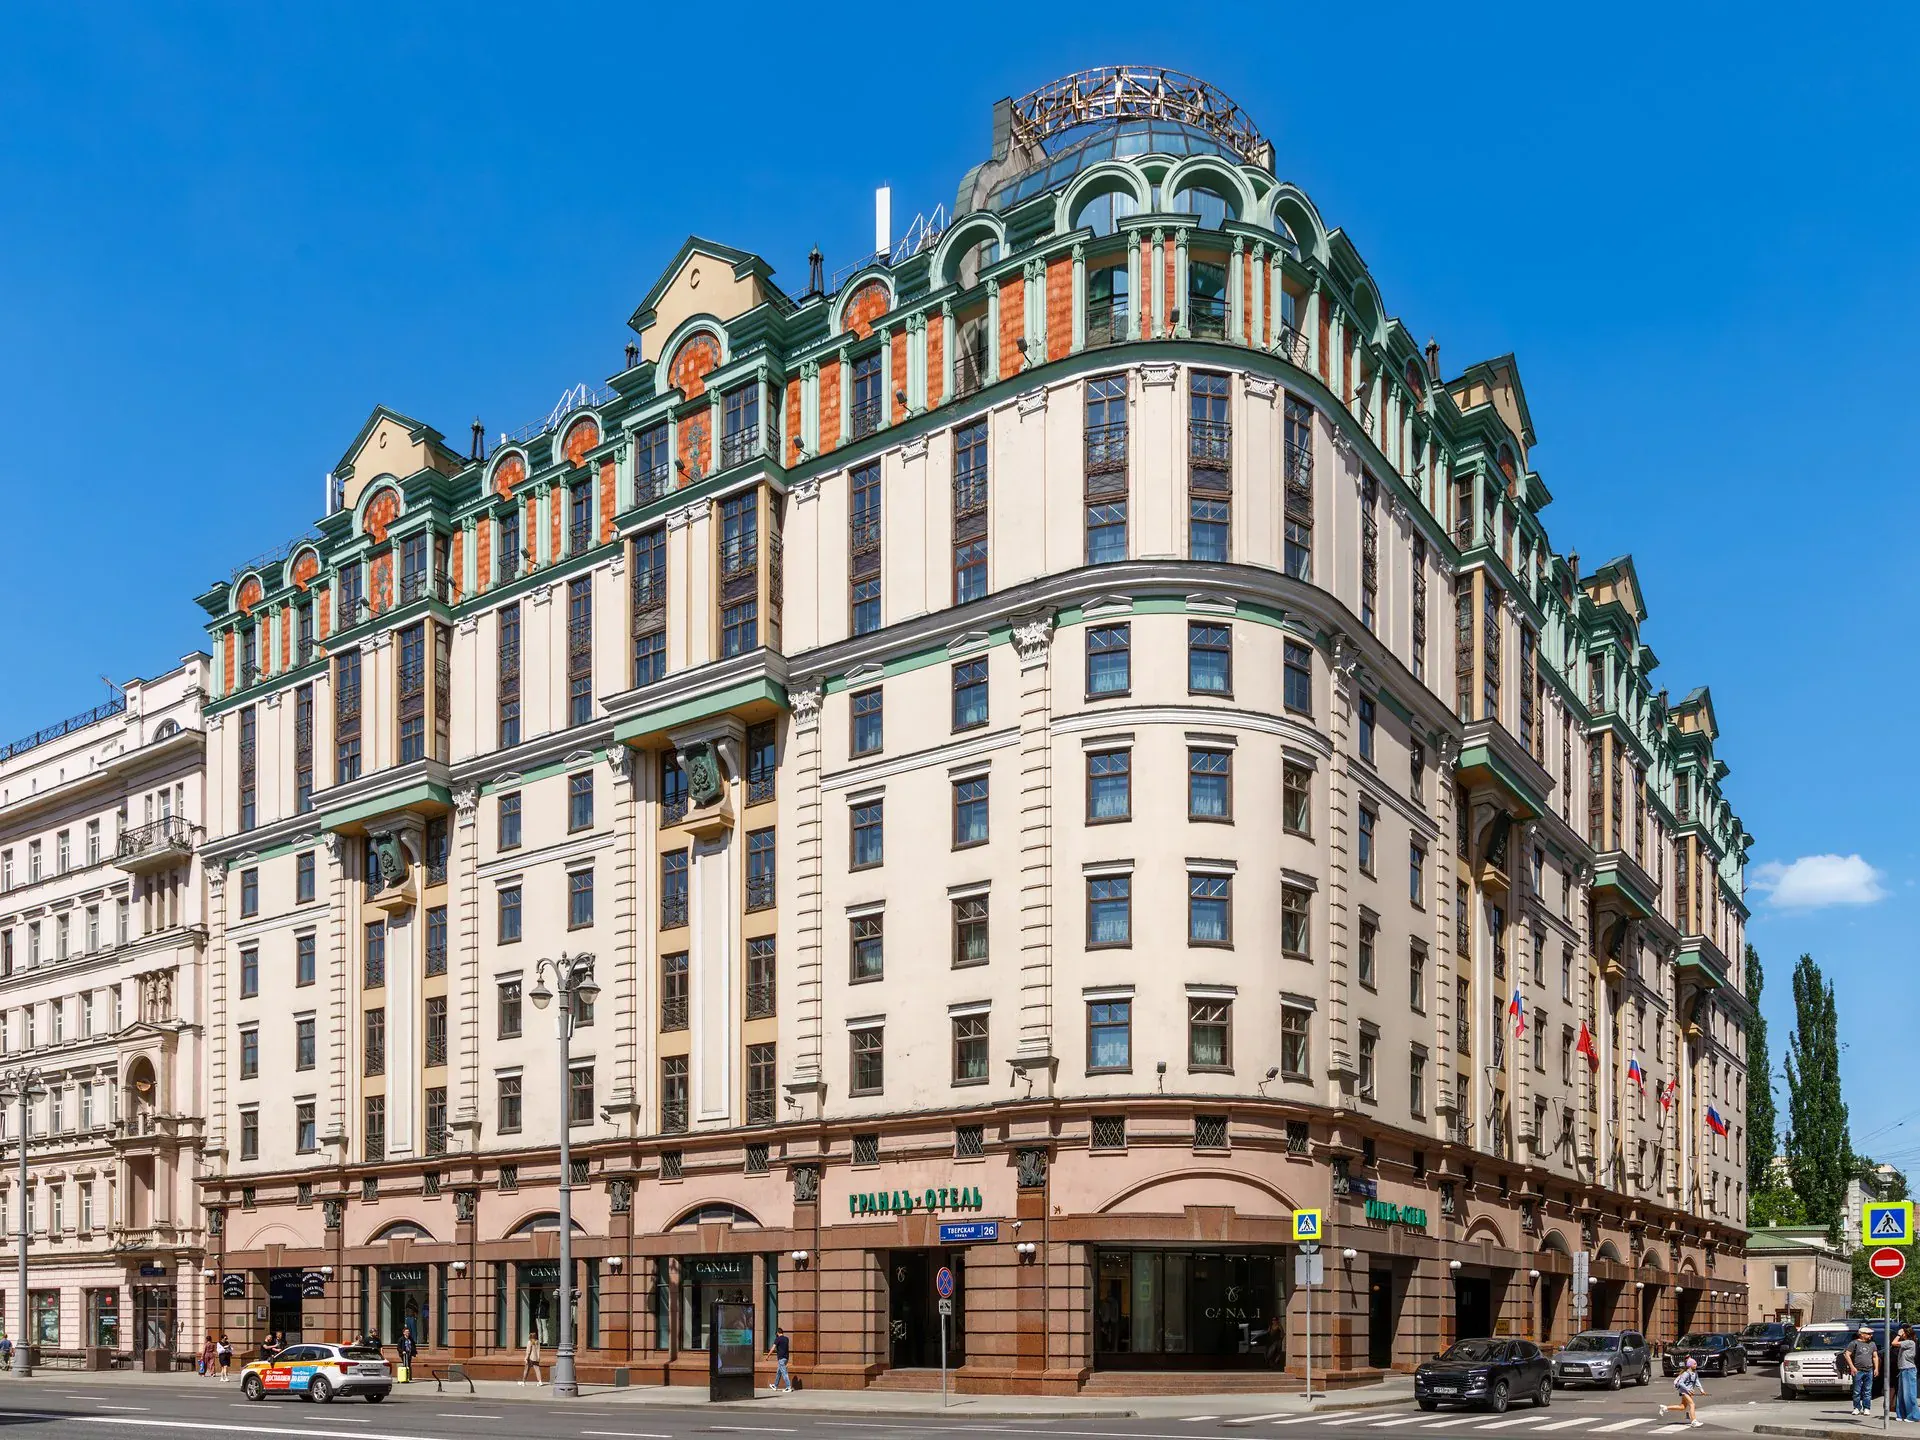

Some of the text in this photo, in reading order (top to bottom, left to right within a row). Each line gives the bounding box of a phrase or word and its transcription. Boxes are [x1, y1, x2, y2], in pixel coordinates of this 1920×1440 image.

[947, 1227, 975, 1235] ТВЕРСКАЯ
[983, 1226, 994, 1236] 26
[530, 1267, 561, 1277] CANA
[696, 1262, 740, 1272] CANALI
[389, 1271, 422, 1280] CANALI
